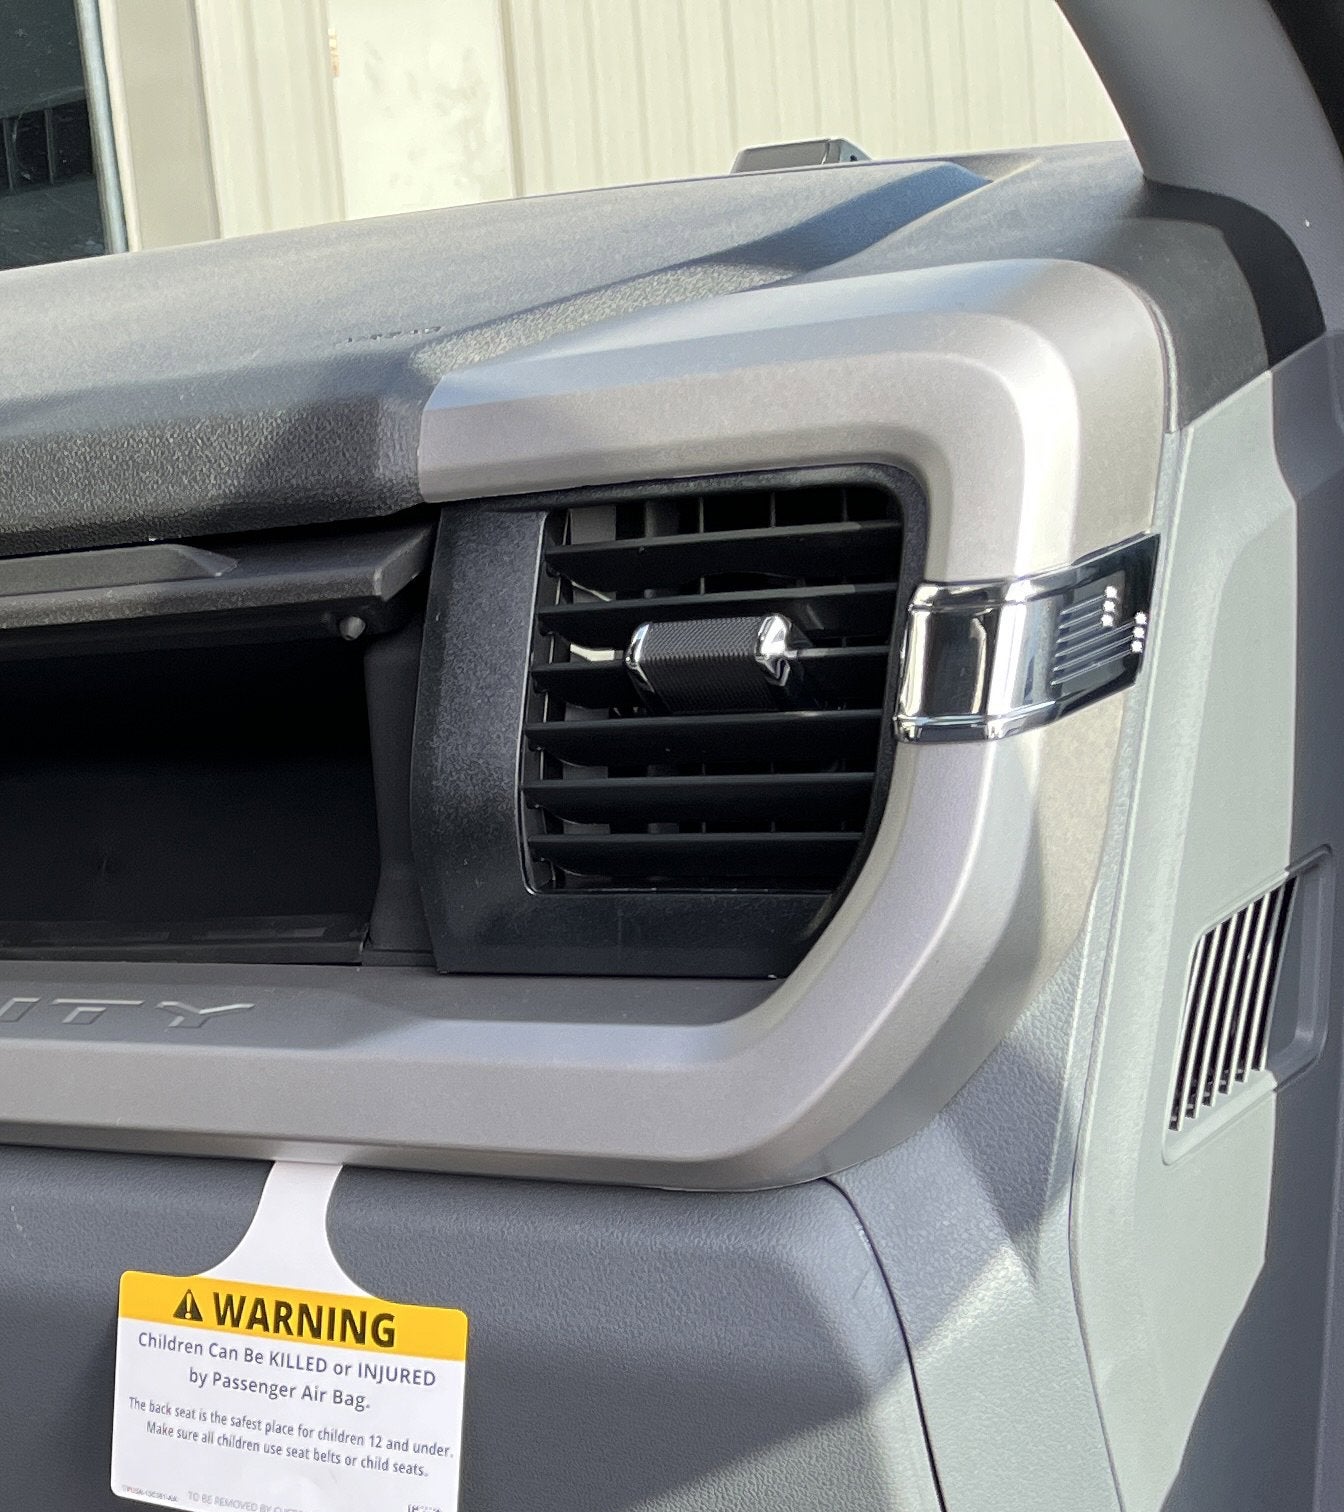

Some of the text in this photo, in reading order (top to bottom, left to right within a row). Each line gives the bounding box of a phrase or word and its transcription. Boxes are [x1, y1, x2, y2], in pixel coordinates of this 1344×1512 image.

[213, 1291, 396, 1348] WARNING
[138, 1331, 437, 1386] Children Can Be KILLED or INJURED
[189, 1366, 370, 1413] by Passenger Air Bag.
[129, 1396, 454, 1458] The back seat is the safest place for children 12 and under.
[146, 1420, 429, 1478] Make sure all children use seat belts or child seats.
[187, 1490, 200, 1501] TO
[201, 1492, 213, 1504] BE
[213, 1495, 259, 1512] REMOVED
